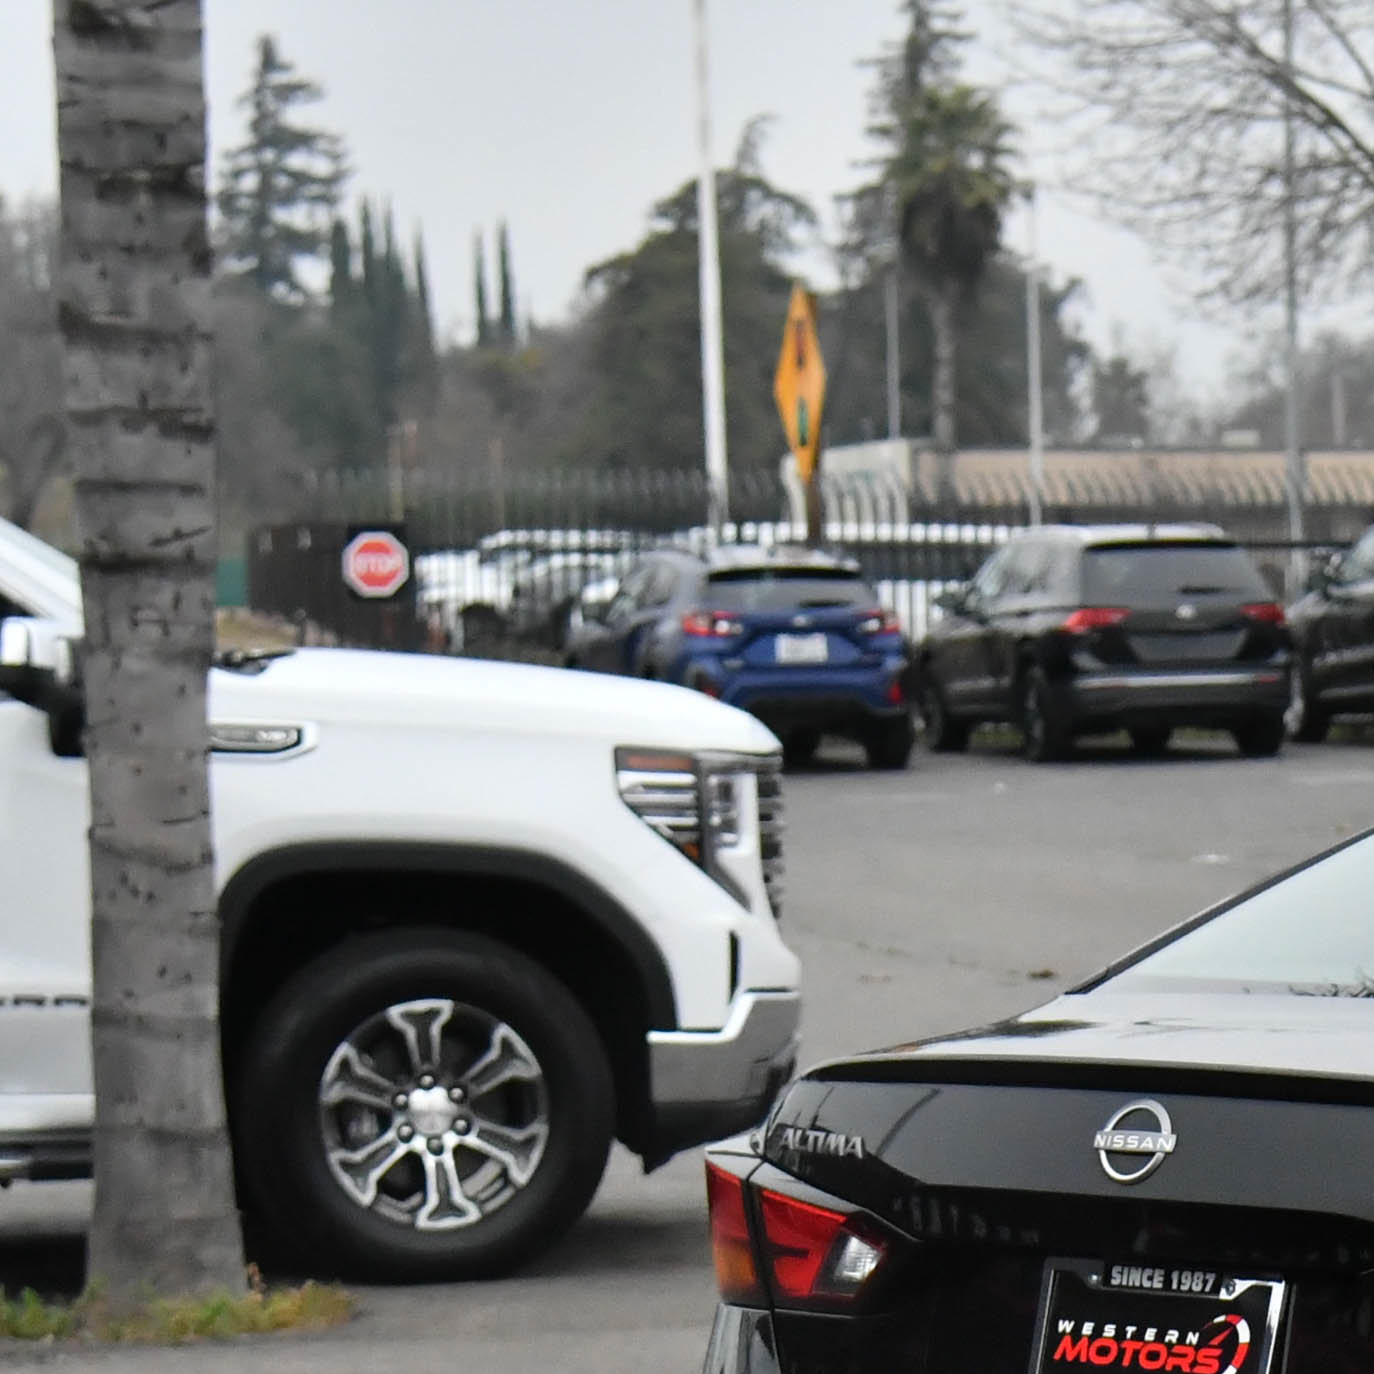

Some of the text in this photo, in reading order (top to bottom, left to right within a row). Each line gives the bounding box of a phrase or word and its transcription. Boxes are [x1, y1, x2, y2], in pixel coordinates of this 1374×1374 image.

[353, 551, 403, 576] STOP
[782, 1127, 864, 1160] ALTIMA
[1093, 1133, 1173, 1152] NISSAN
[1110, 1264, 1216, 1293] SINCE 1987
[1057, 1319, 1201, 1345] WESTERN
